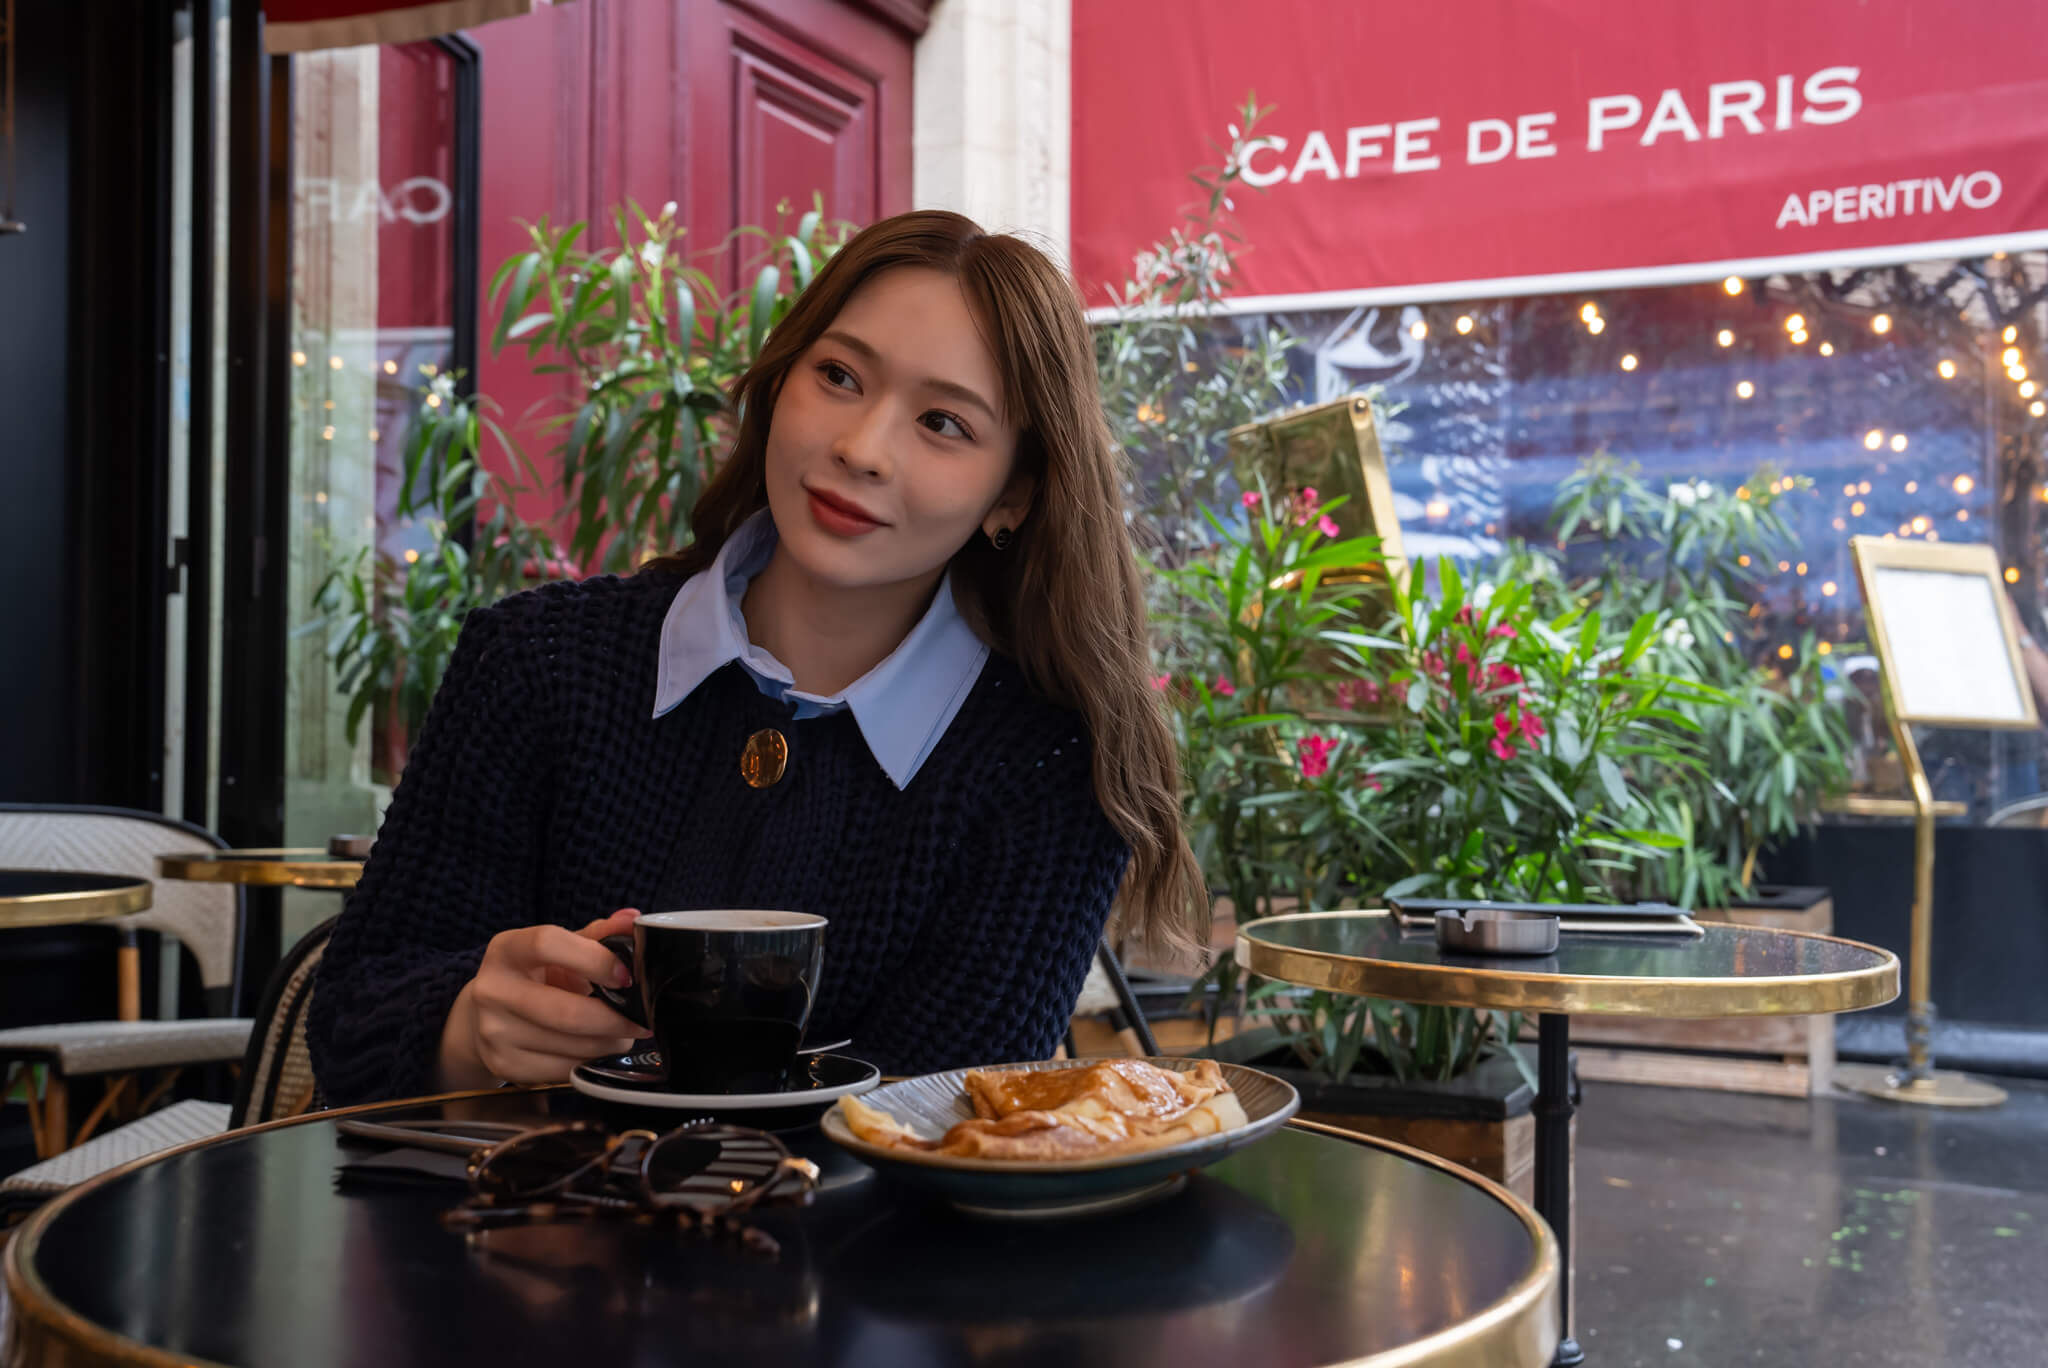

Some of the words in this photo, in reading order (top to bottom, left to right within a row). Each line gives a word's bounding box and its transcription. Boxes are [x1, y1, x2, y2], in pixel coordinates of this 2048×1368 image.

[1239, 117, 1440, 187] CAFE
[1466, 112, 1557, 165] DE
[1587, 66, 1862, 152] PARIS
[1776, 170, 2002, 229] APERITIVO
